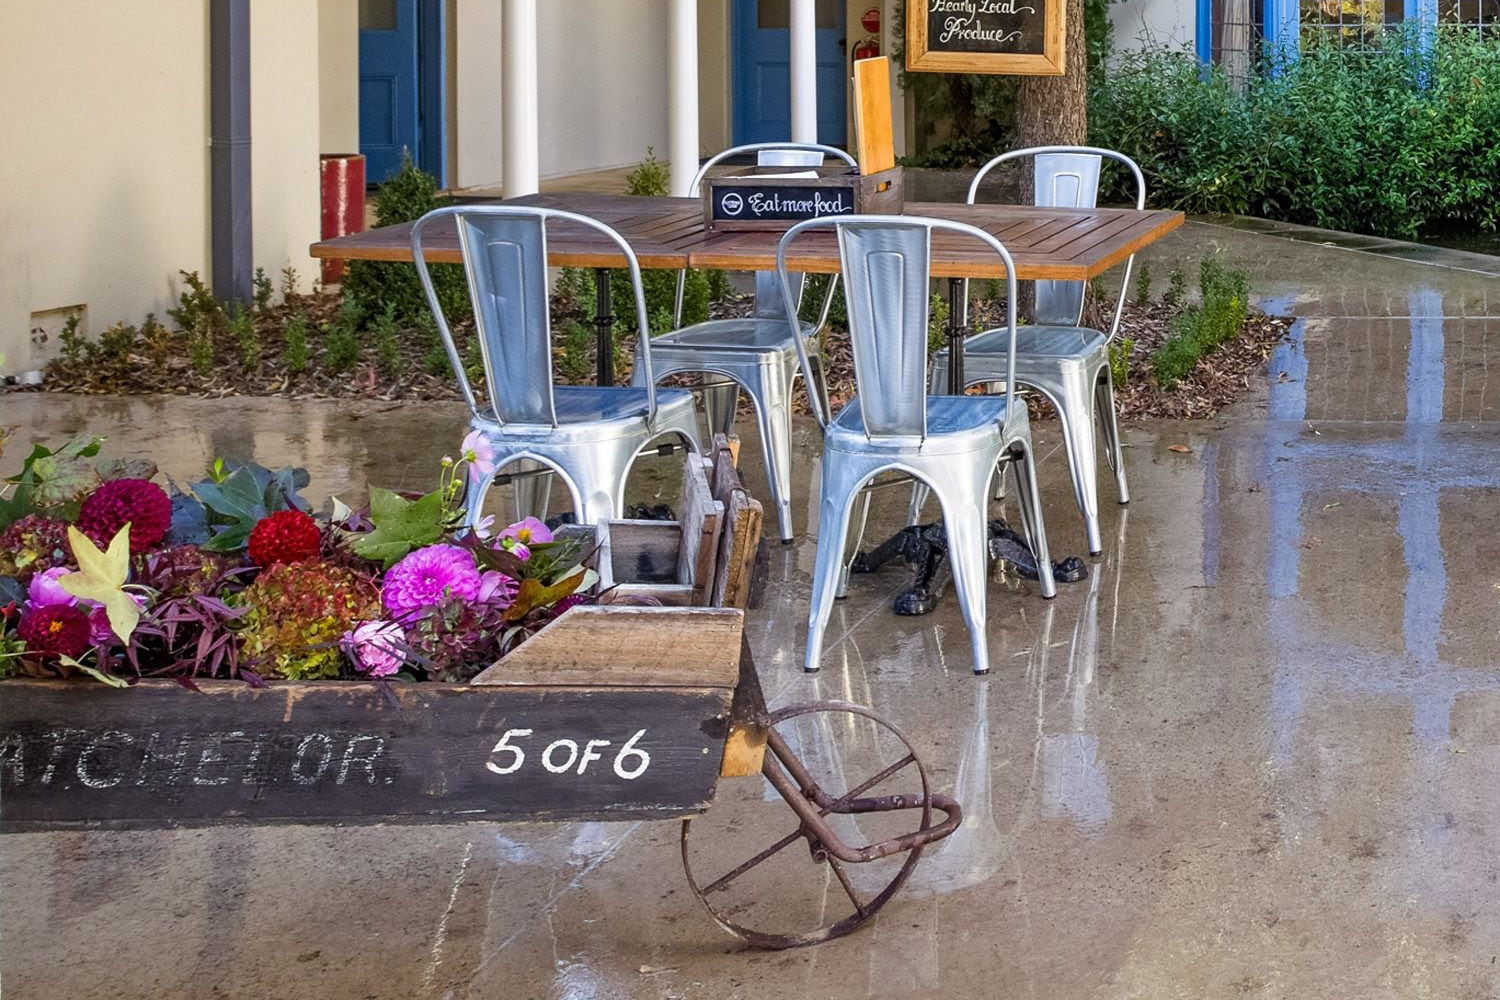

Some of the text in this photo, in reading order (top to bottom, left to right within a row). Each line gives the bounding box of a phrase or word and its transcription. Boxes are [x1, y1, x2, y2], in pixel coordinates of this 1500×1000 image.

[939, 16, 1023, 43] Produce.
[748, 191, 852, 217] Eat more food
[487, 728, 533, 775] 5
[541, 738, 611, 775] OF
[612, 728, 651, 780] 6
